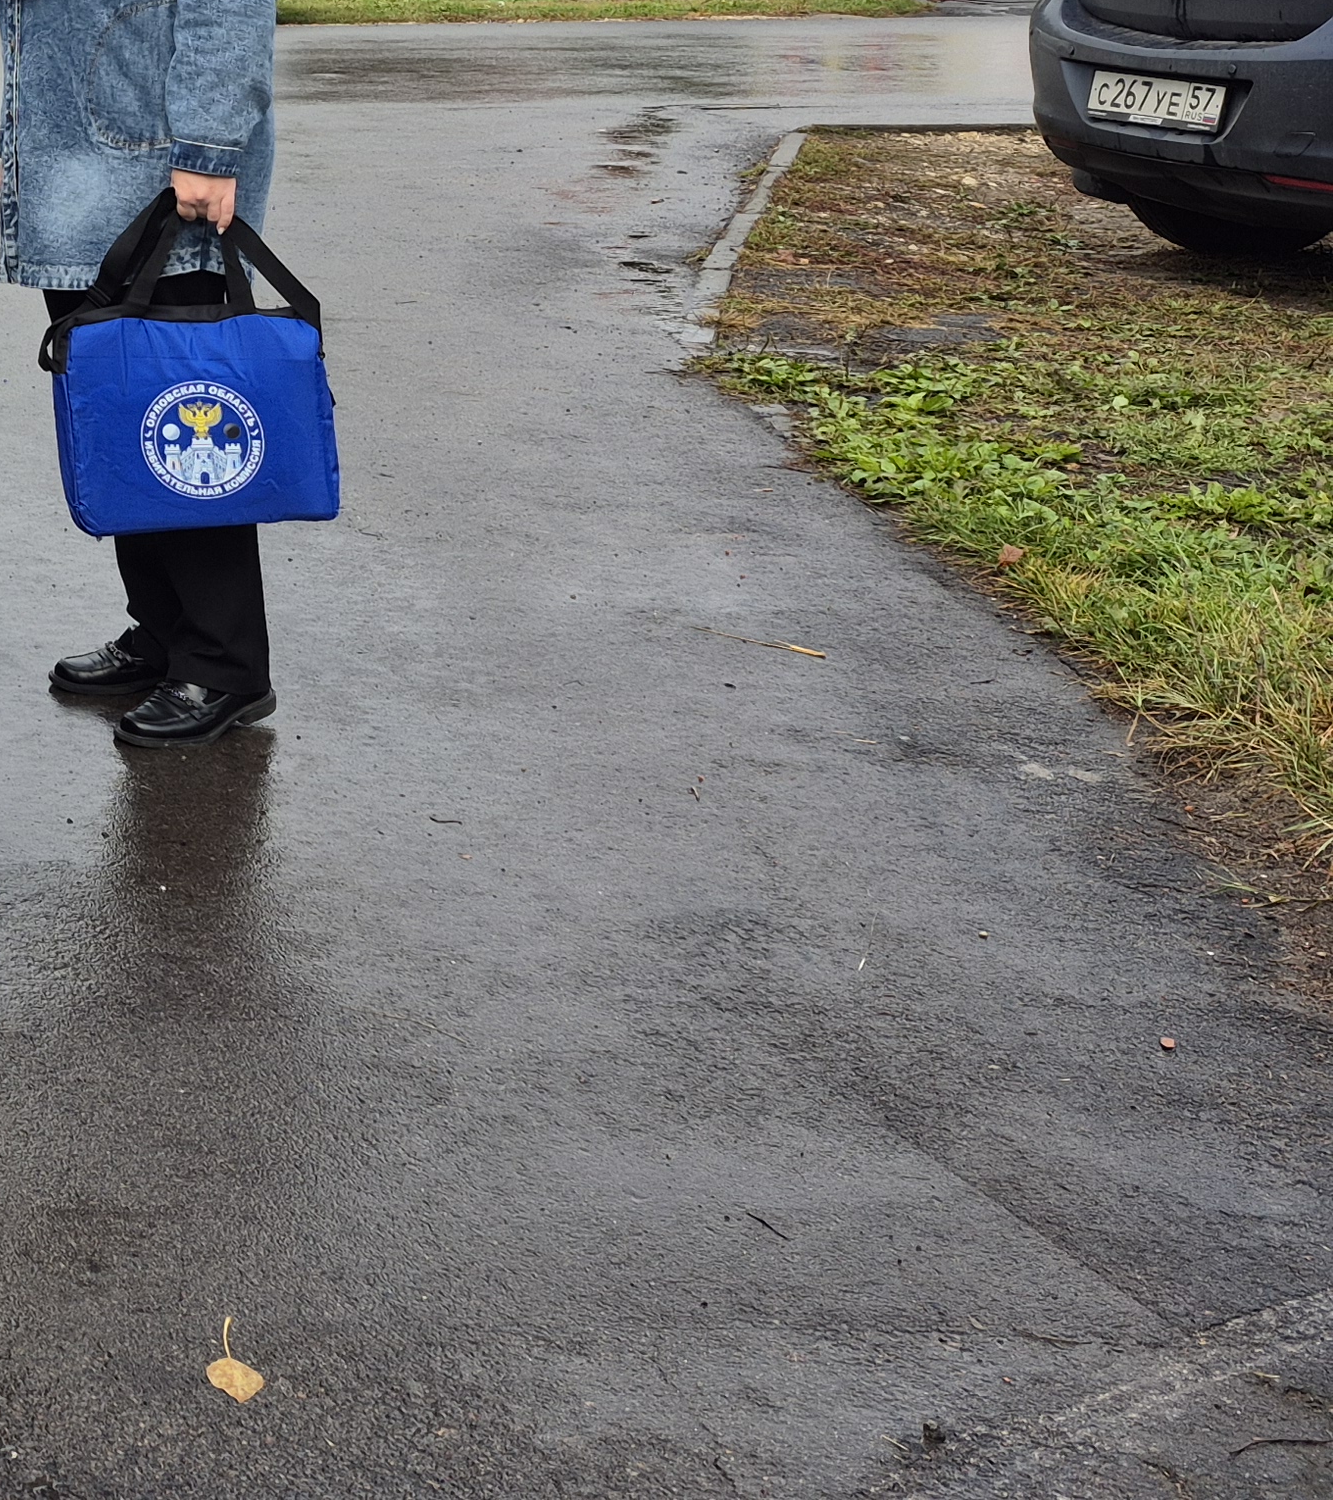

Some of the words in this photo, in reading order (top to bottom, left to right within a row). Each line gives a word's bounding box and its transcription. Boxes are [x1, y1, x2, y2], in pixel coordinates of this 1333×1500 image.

[1097, 78, 1183, 117] С267УЕ
[1189, 86, 1216, 112] 57
[1185, 111, 1203, 121] RUS
[146, 384, 205, 428] ОРЛОВСКАЯ
[208, 386, 255, 428] ОБЛАСТЬ
[144, 440, 223, 496] ИЗБИРАТЕЛЬНАЯ
[225, 439, 261, 492] КОМИССИЯ
